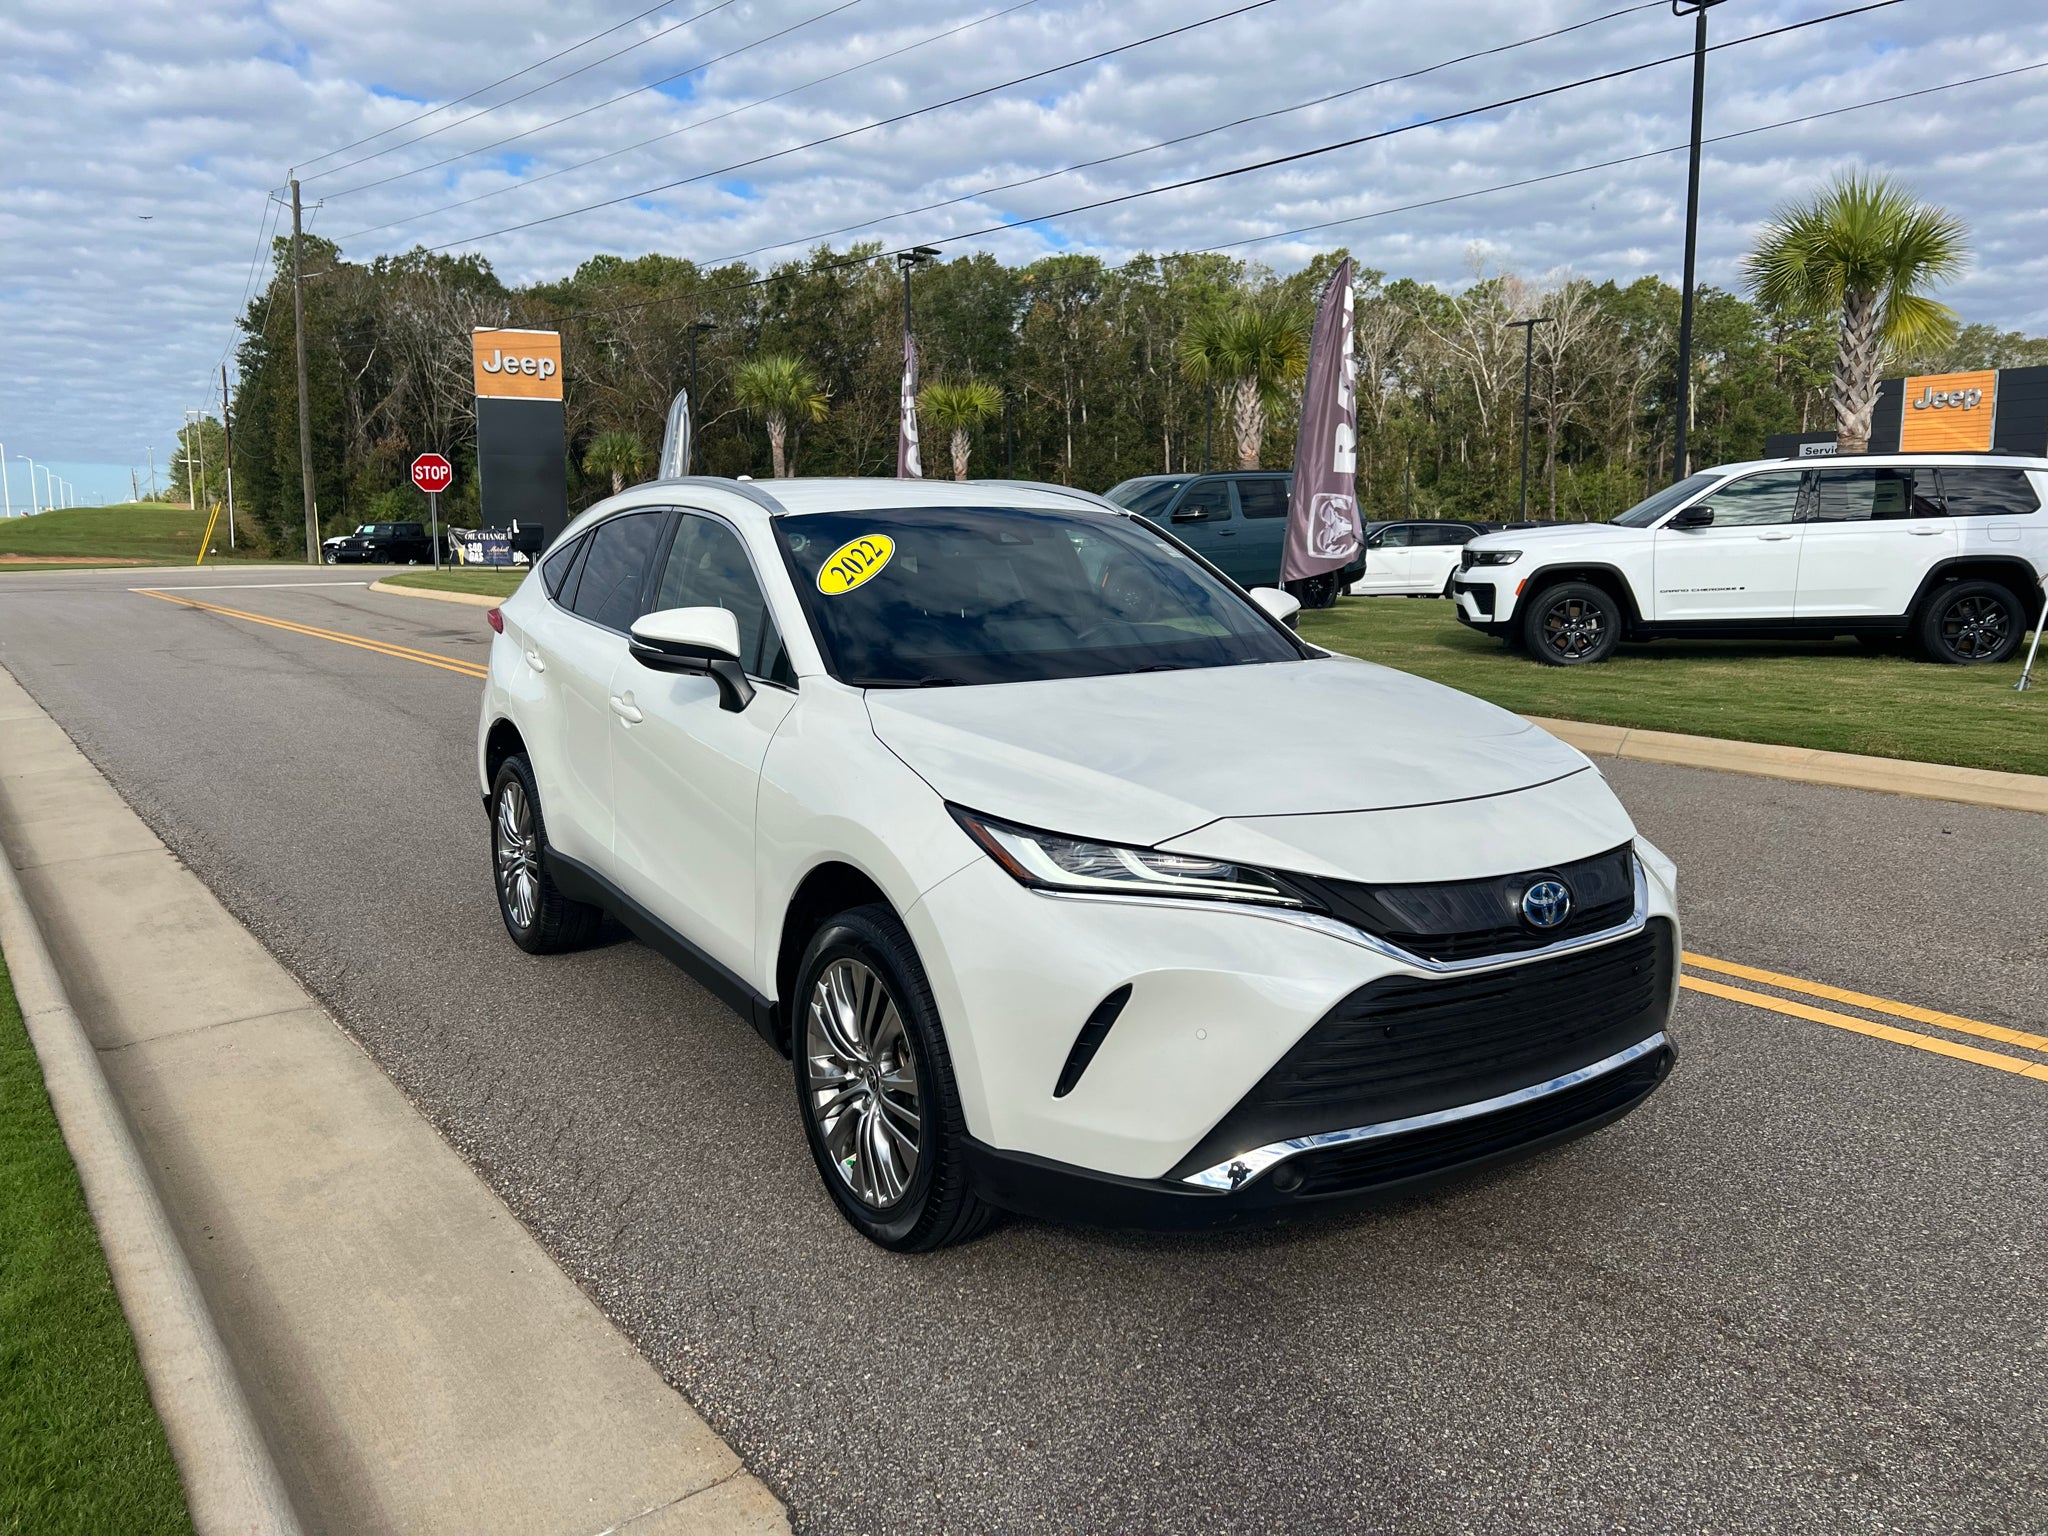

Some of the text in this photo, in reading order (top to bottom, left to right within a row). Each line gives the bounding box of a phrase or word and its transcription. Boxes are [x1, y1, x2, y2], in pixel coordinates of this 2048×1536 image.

[482, 349, 556, 380] Jeep
[1913, 386, 1983, 411] Jeep
[415, 465, 449, 480] STOP
[464, 532, 508, 540] OIL CHANGE
[467, 543, 482, 553] $40
[469, 552, 484, 562] GAS
[830, 541, 884, 586] 2022
